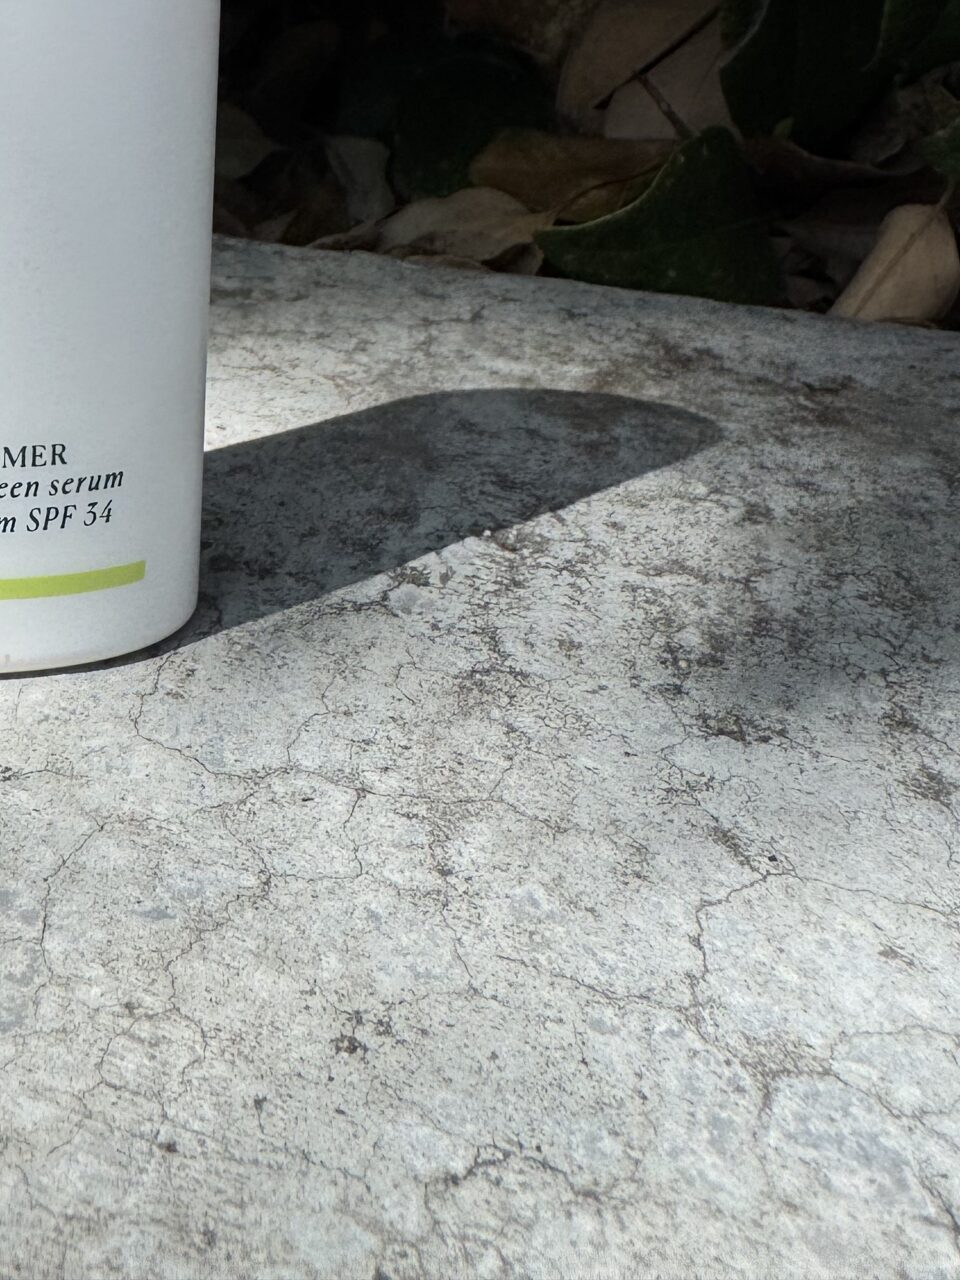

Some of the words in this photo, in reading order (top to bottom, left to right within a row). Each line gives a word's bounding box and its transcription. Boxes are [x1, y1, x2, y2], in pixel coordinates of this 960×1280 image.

[49, 471, 124, 497] serum
[26, 505, 78, 533] SPF
[84, 499, 113, 527] 34
